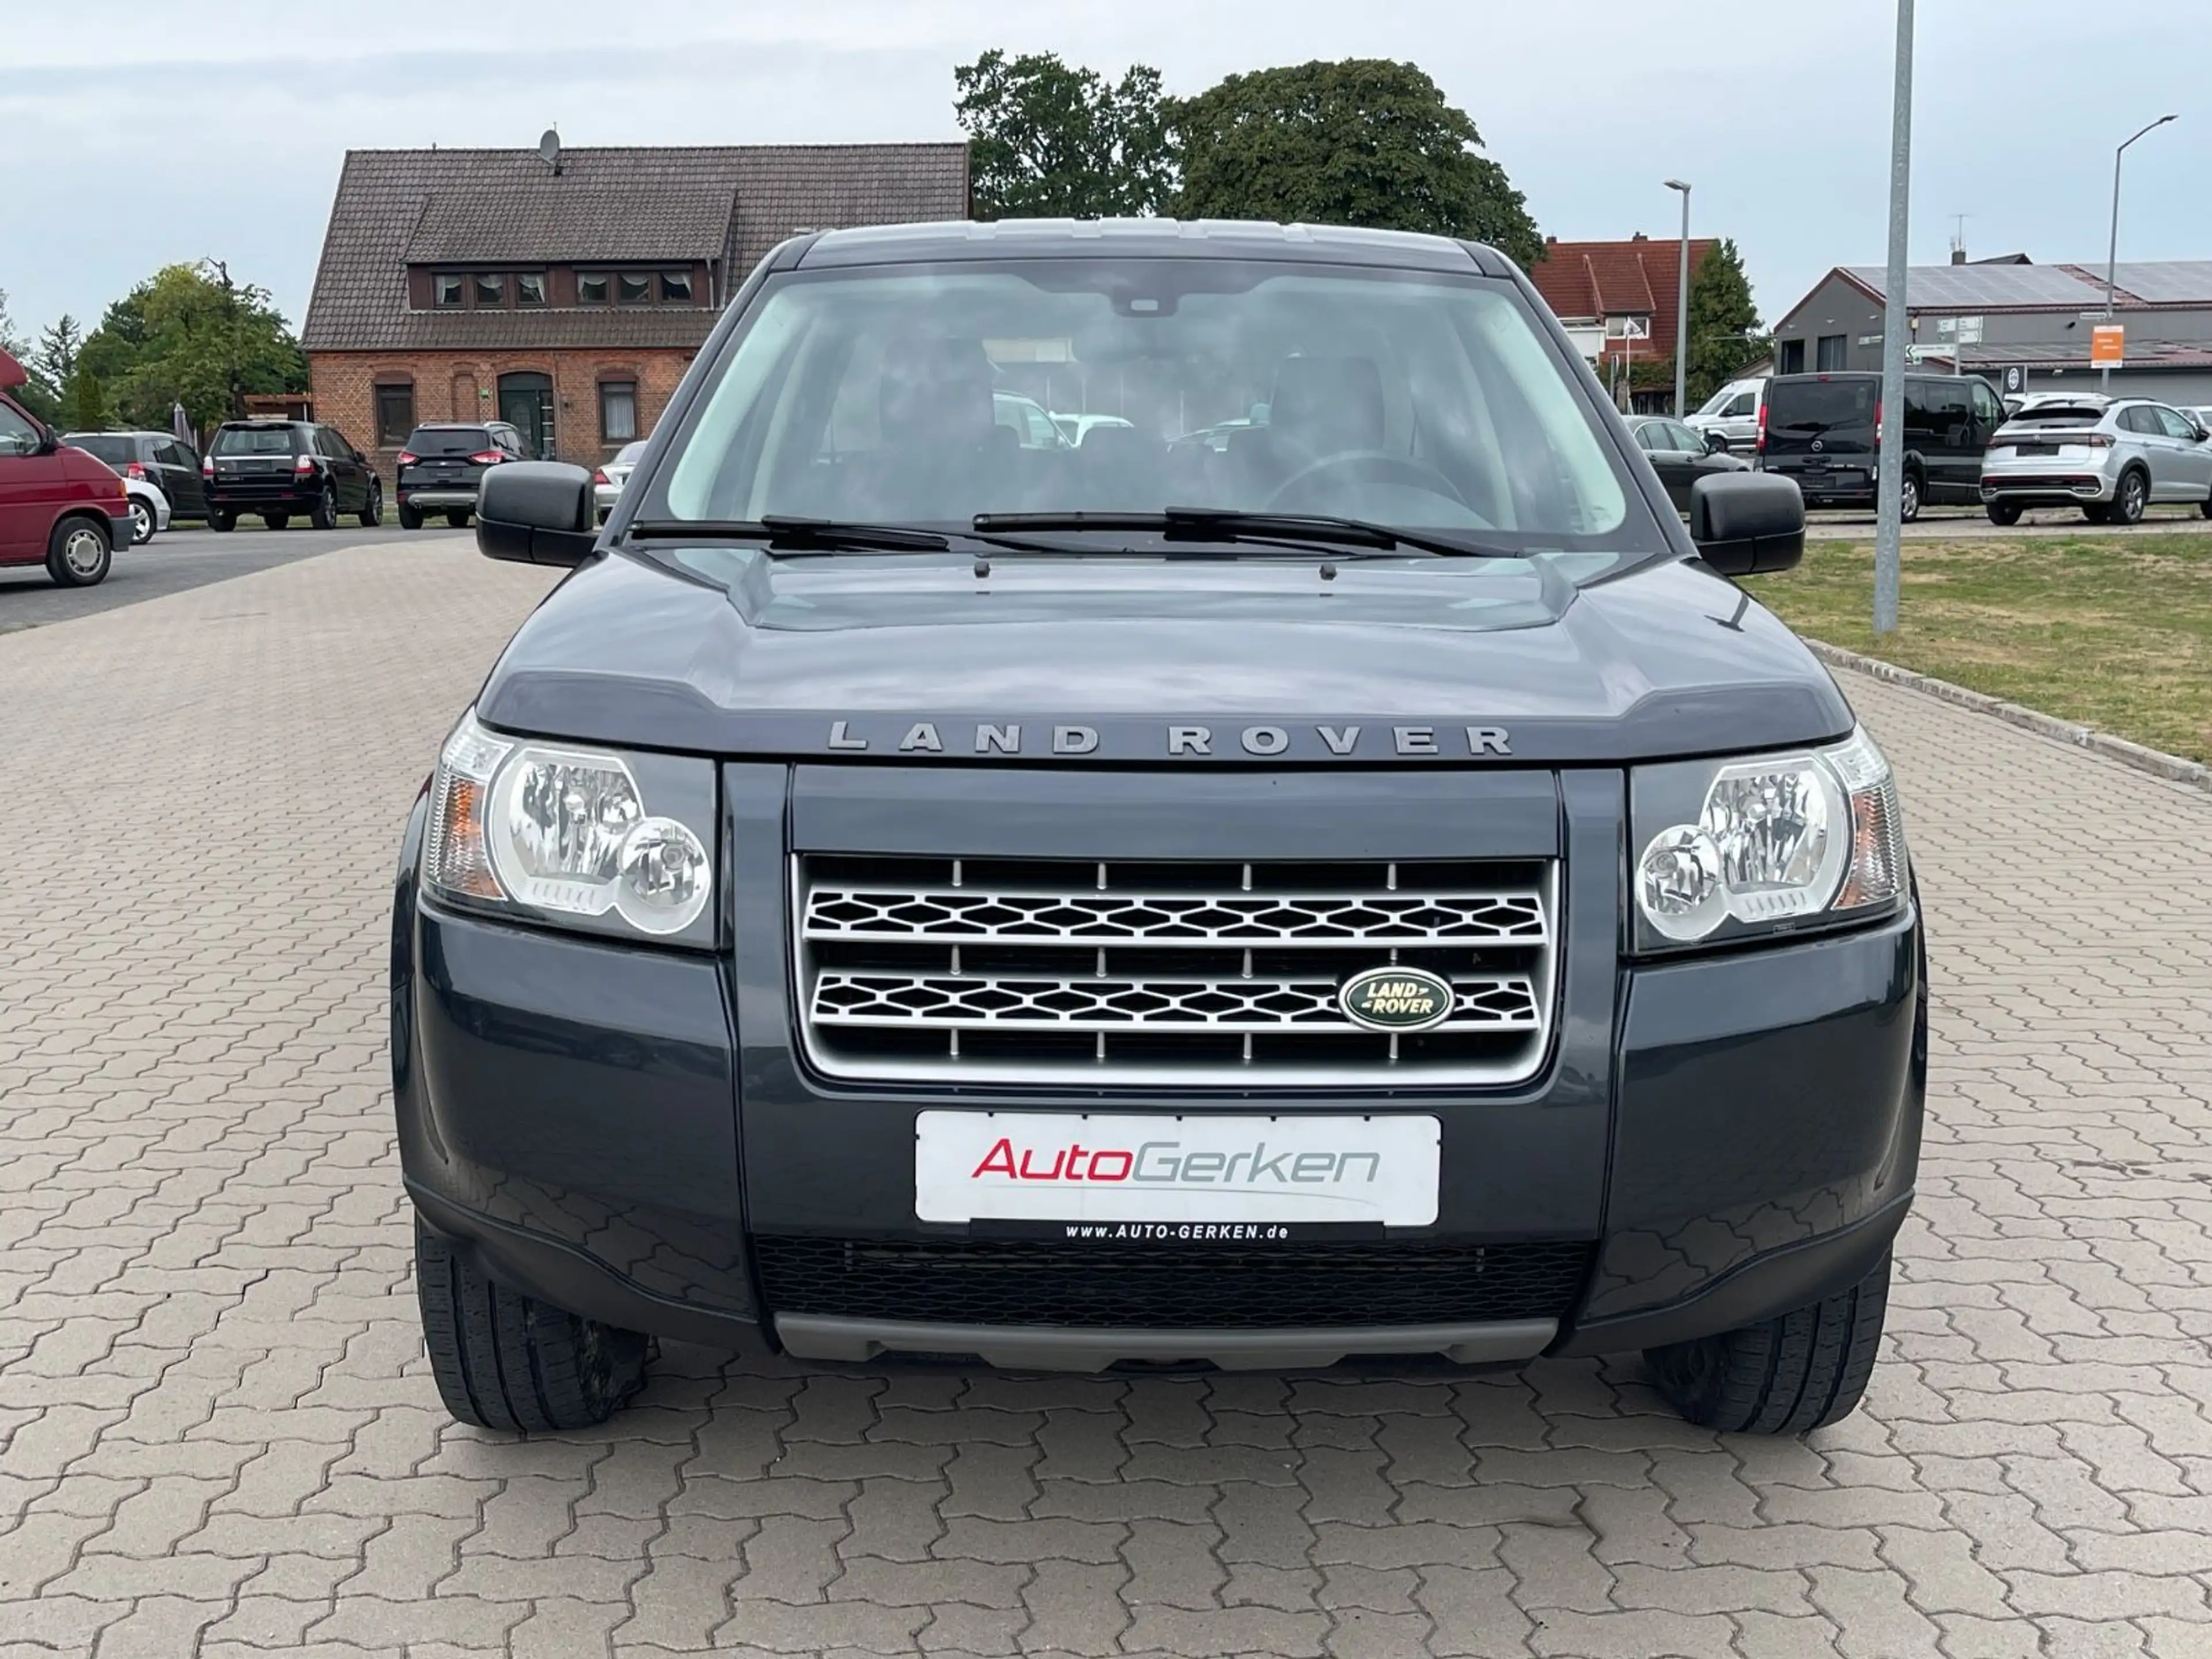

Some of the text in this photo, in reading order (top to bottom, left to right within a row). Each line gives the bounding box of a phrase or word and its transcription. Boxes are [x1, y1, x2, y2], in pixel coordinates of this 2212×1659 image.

[828, 721, 1512, 756] LAND ROVER
[1367, 983, 1417, 998] LAND
[1372, 999, 1433, 1013] ROVER
[972, 1138, 1380, 1183] AutoGerken
[1066, 1224, 1288, 1239] www.AUTO-GERKEN.de
